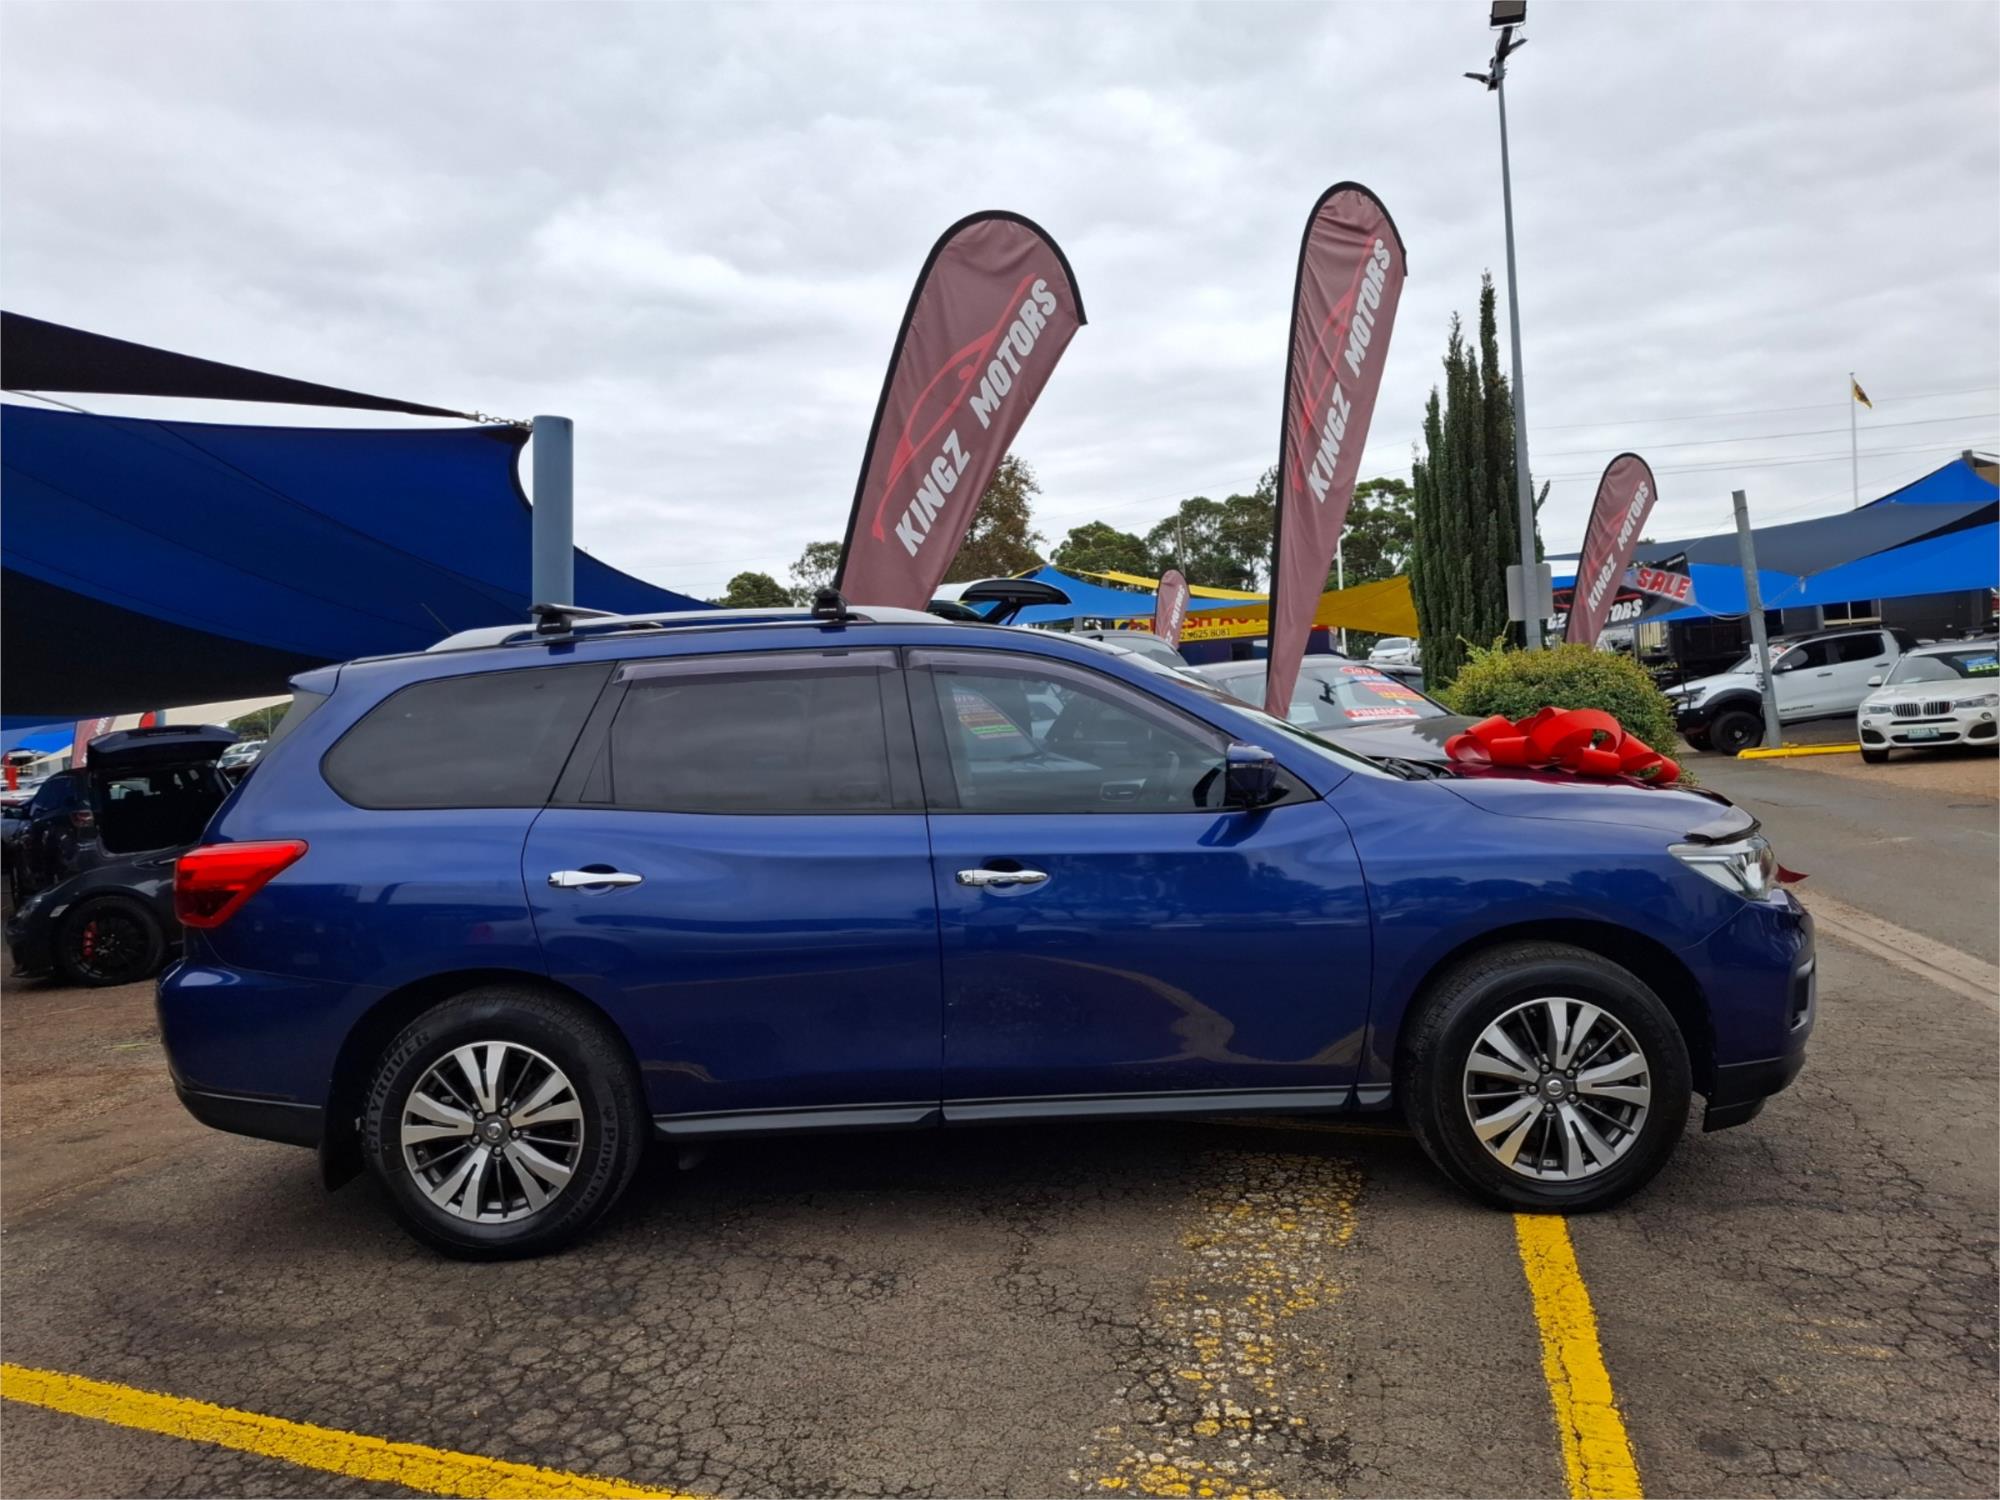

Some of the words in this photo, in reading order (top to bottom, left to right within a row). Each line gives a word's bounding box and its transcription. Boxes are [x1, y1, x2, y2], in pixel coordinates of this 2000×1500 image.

[894, 429, 971, 557] KINGZ
[969, 278, 1057, 430] MOTORS
[1308, 381, 1351, 503] KINGZ
[1344, 237, 1391, 379] MOTORS
[1587, 553, 1617, 613] KINGZ
[1616, 480, 1649, 551] MOTORS
[1636, 567, 1691, 600] SALE
